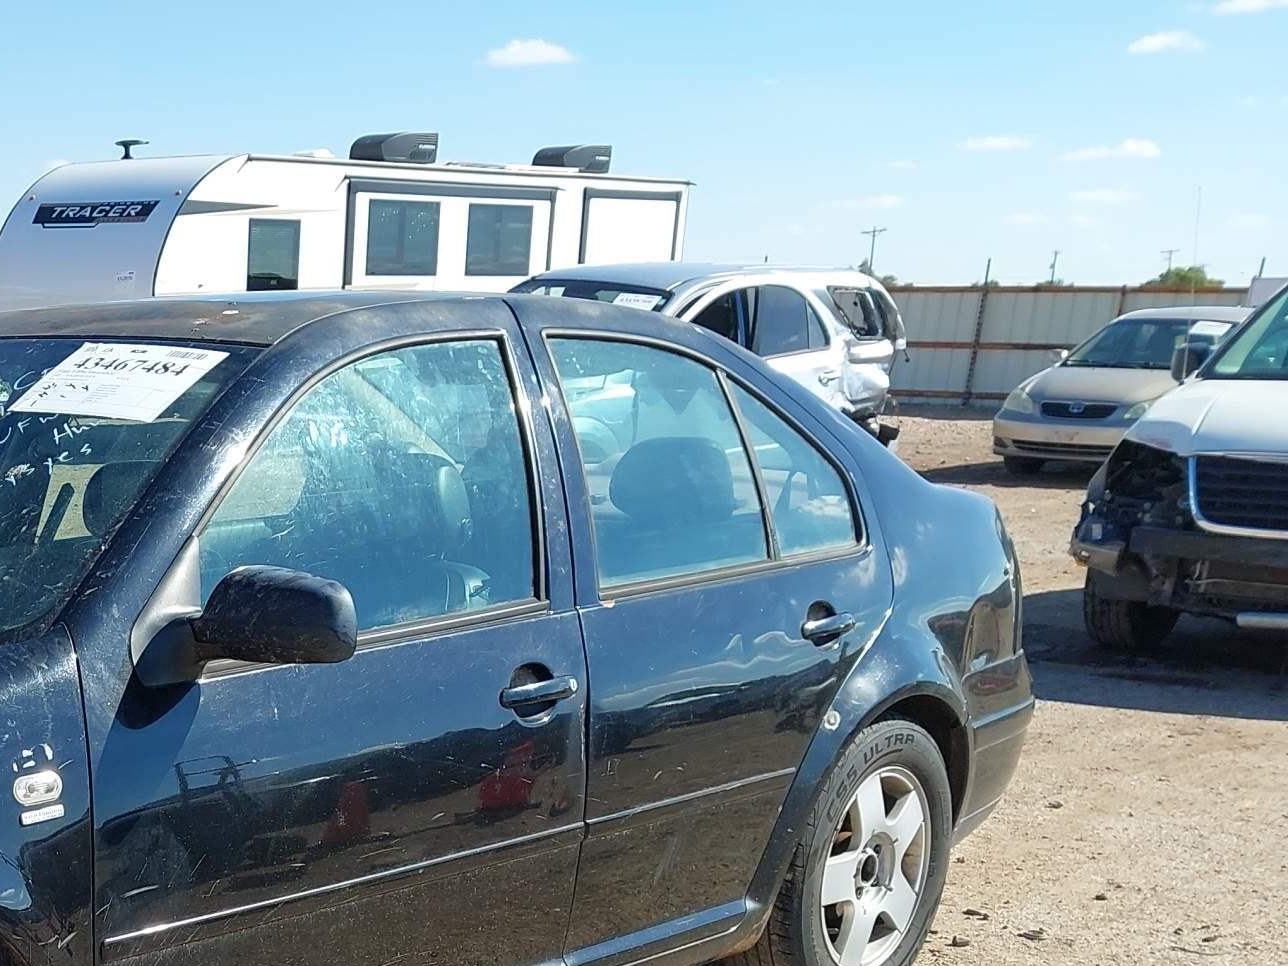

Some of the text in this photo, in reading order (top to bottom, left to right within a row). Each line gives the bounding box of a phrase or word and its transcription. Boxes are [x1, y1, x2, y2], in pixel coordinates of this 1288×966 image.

[51, 205, 143, 219] TRACER
[73, 356, 191, 376] 43467484
[863, 732, 916, 765] ULTRA
